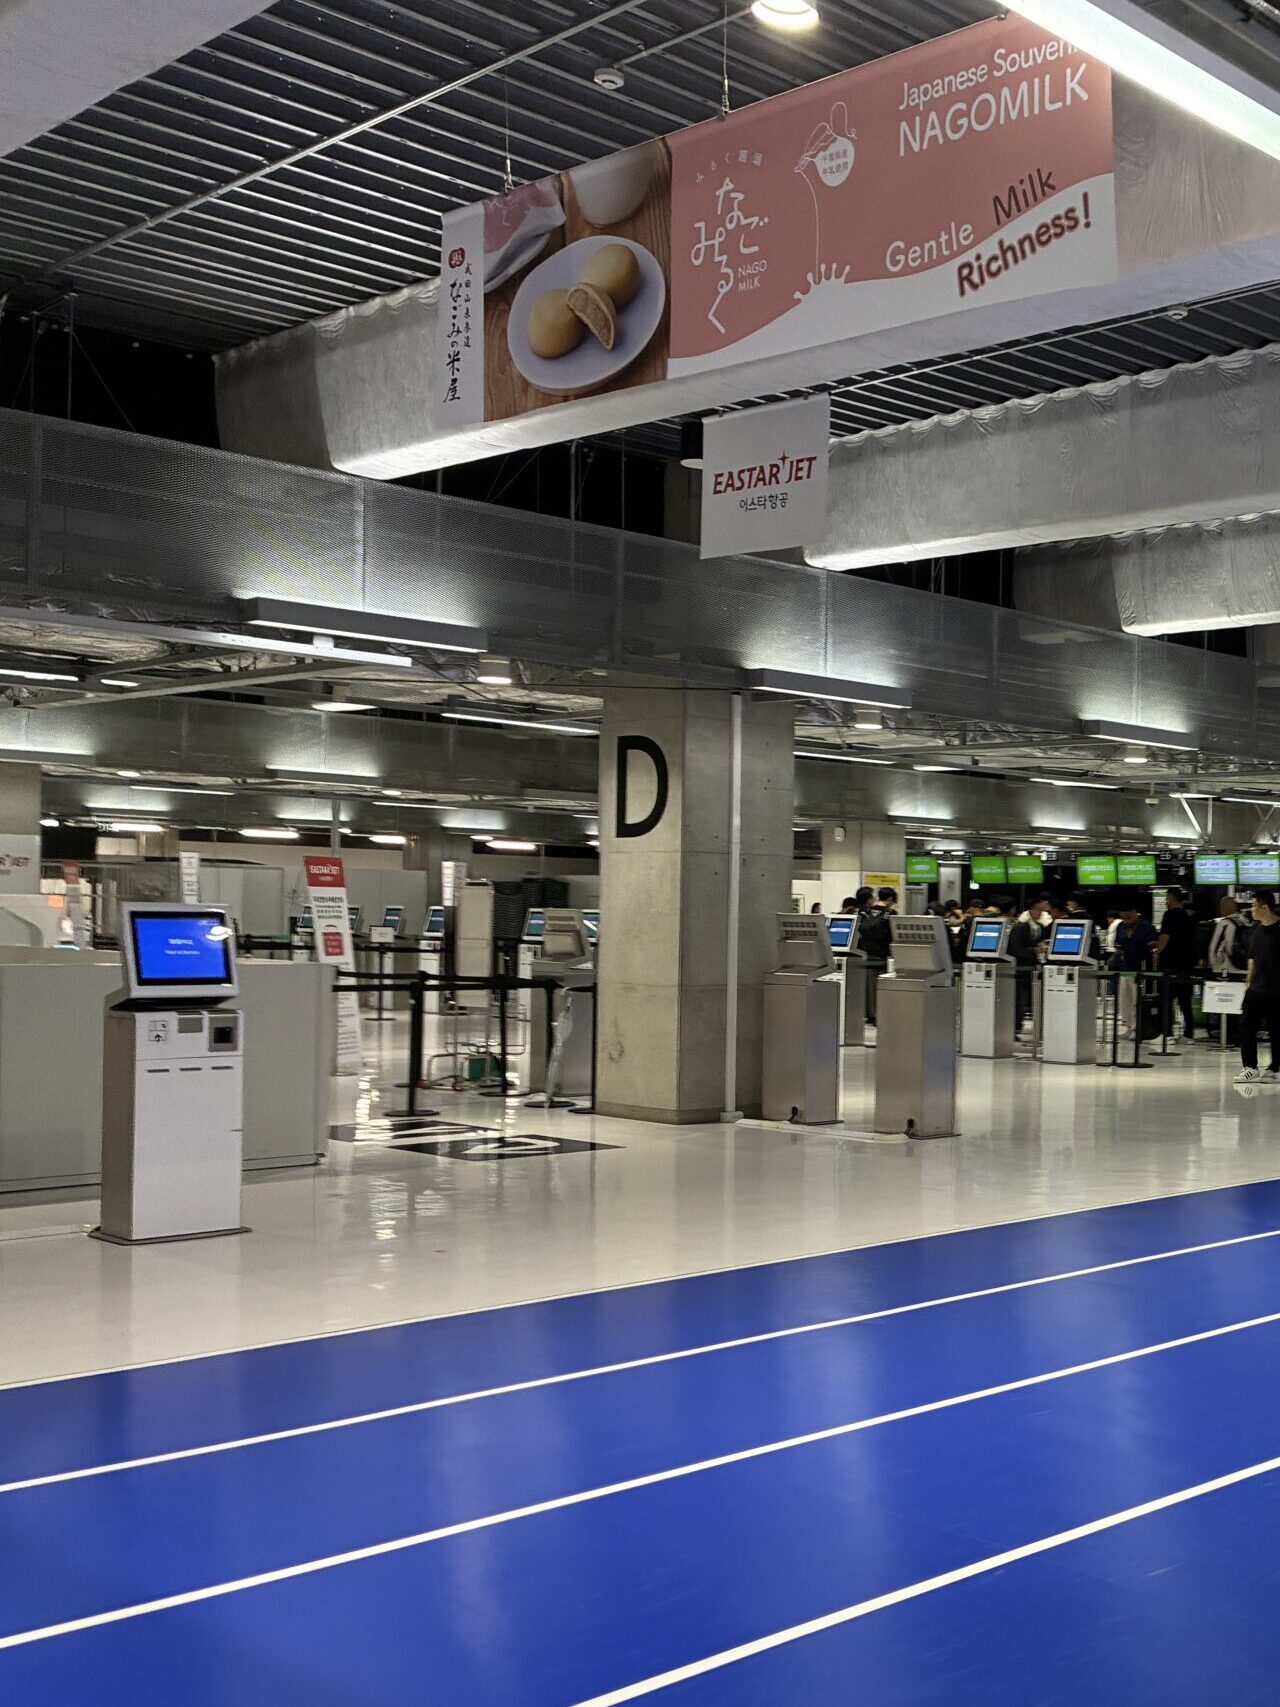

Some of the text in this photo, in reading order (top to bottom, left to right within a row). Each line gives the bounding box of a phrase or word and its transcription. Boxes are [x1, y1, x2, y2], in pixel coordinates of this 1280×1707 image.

[899, 38, 1077, 111] Japanese Souven
[899, 62, 1089, 156] NAGOMILK
[885, 167, 1057, 273] Gentle Milk
[956, 190, 1092, 298] Richness!
[738, 259, 768, 276] NAGO
[738, 279, 760, 293] MILK
[739, 491, 789, 512] 이스타항공
[616, 735, 668, 838] D
